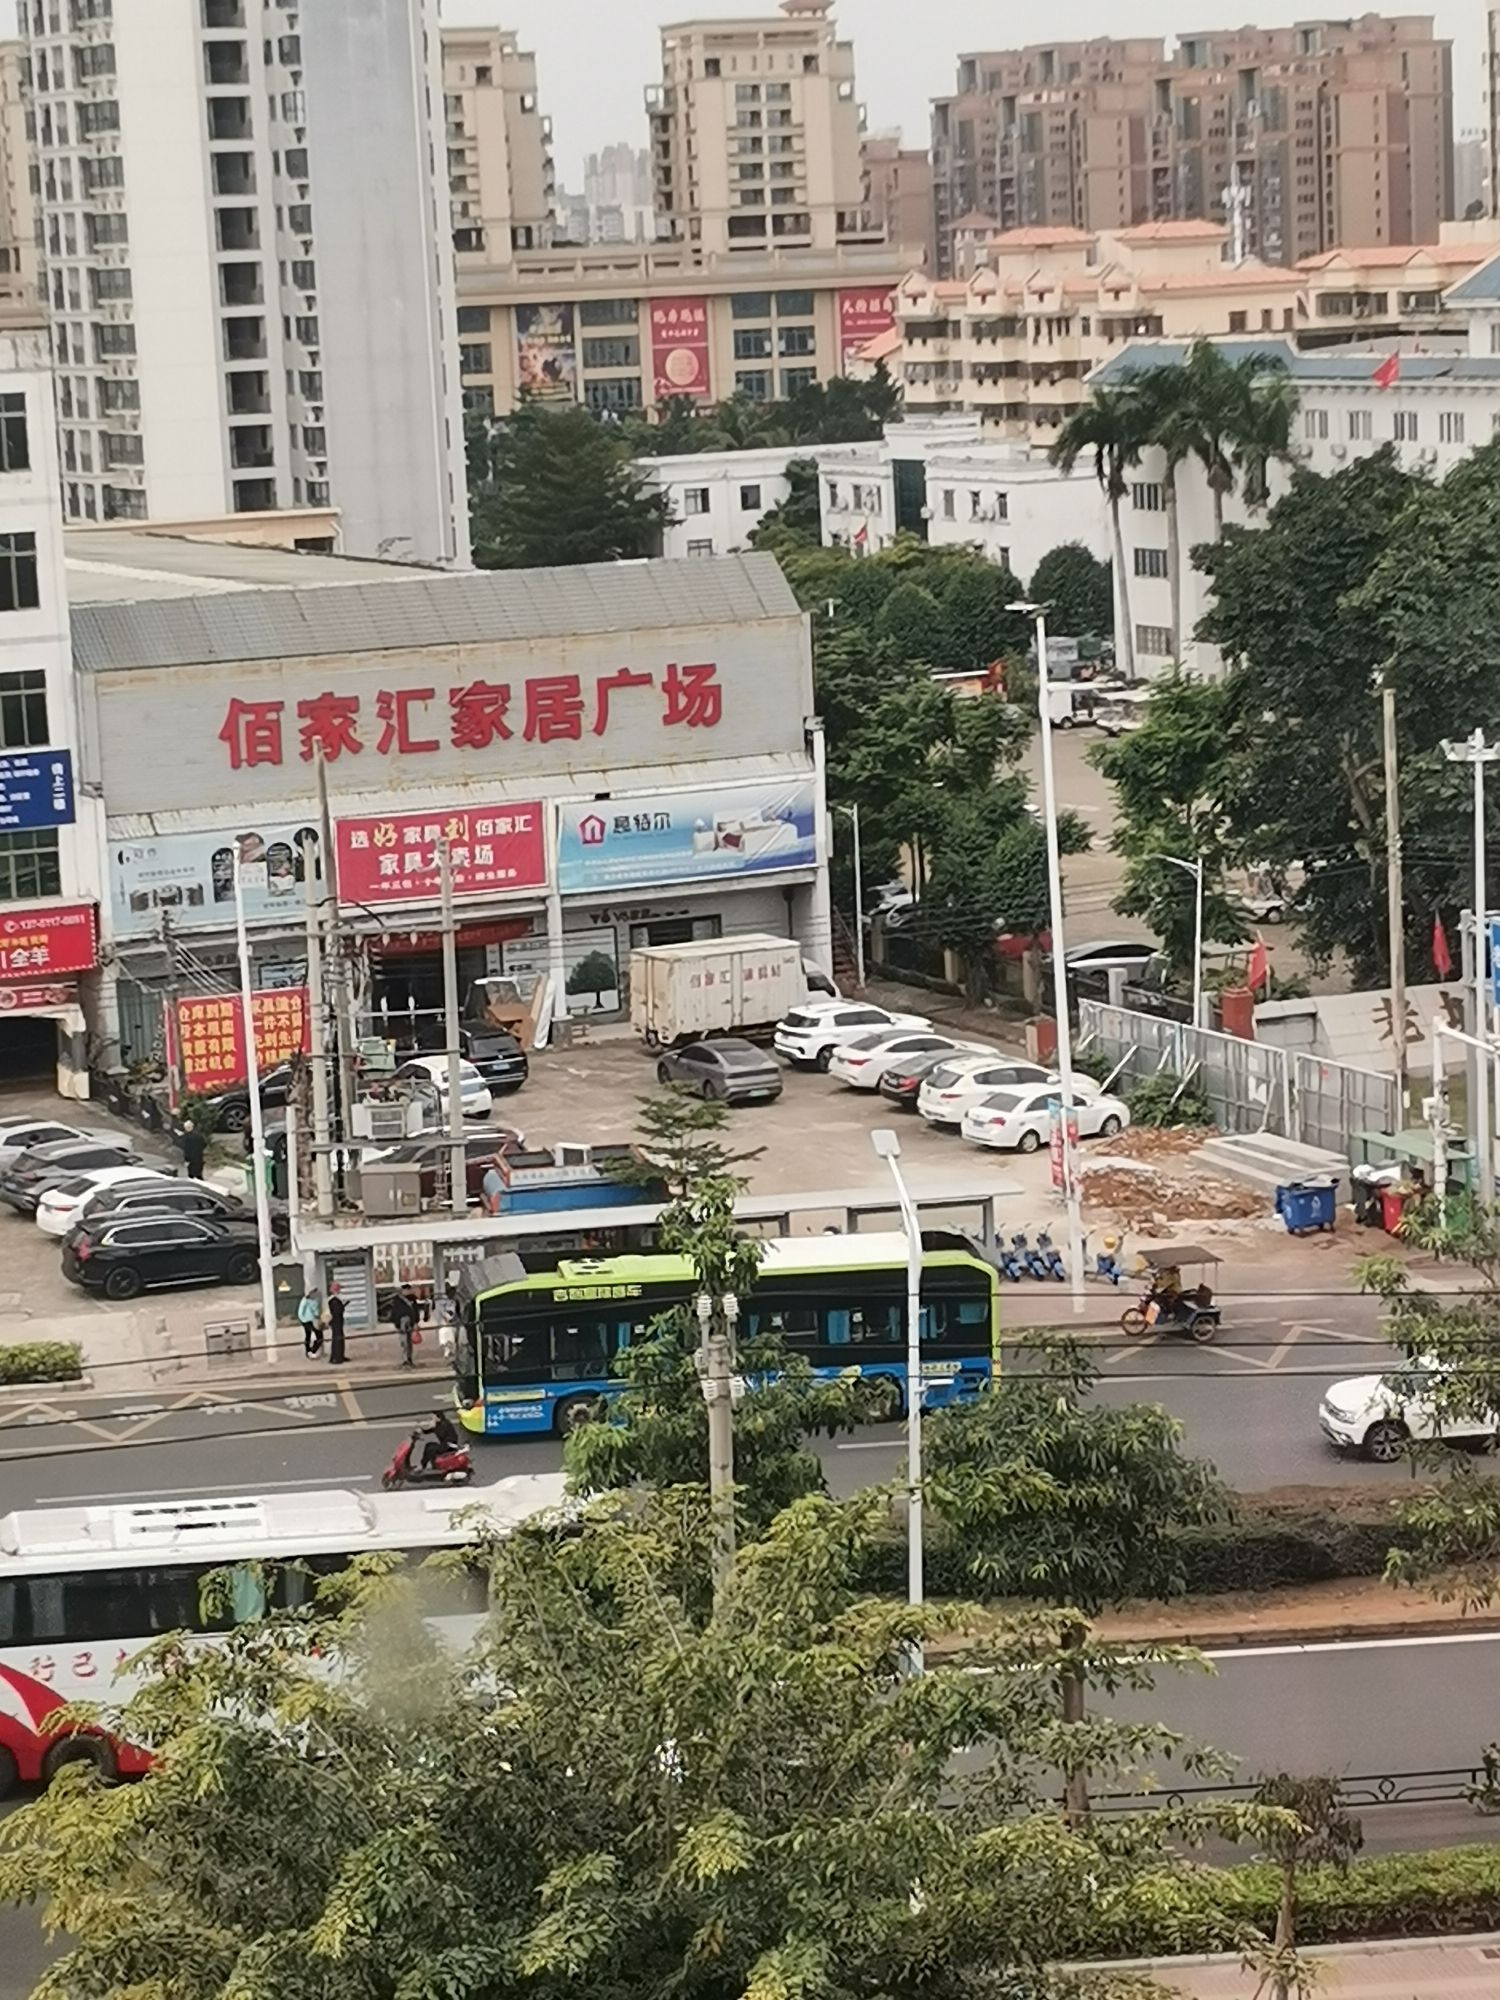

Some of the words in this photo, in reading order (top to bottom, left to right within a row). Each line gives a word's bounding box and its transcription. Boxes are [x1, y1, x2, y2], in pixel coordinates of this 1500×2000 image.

[218, 663, 722, 769] 佰家汇家居广场
